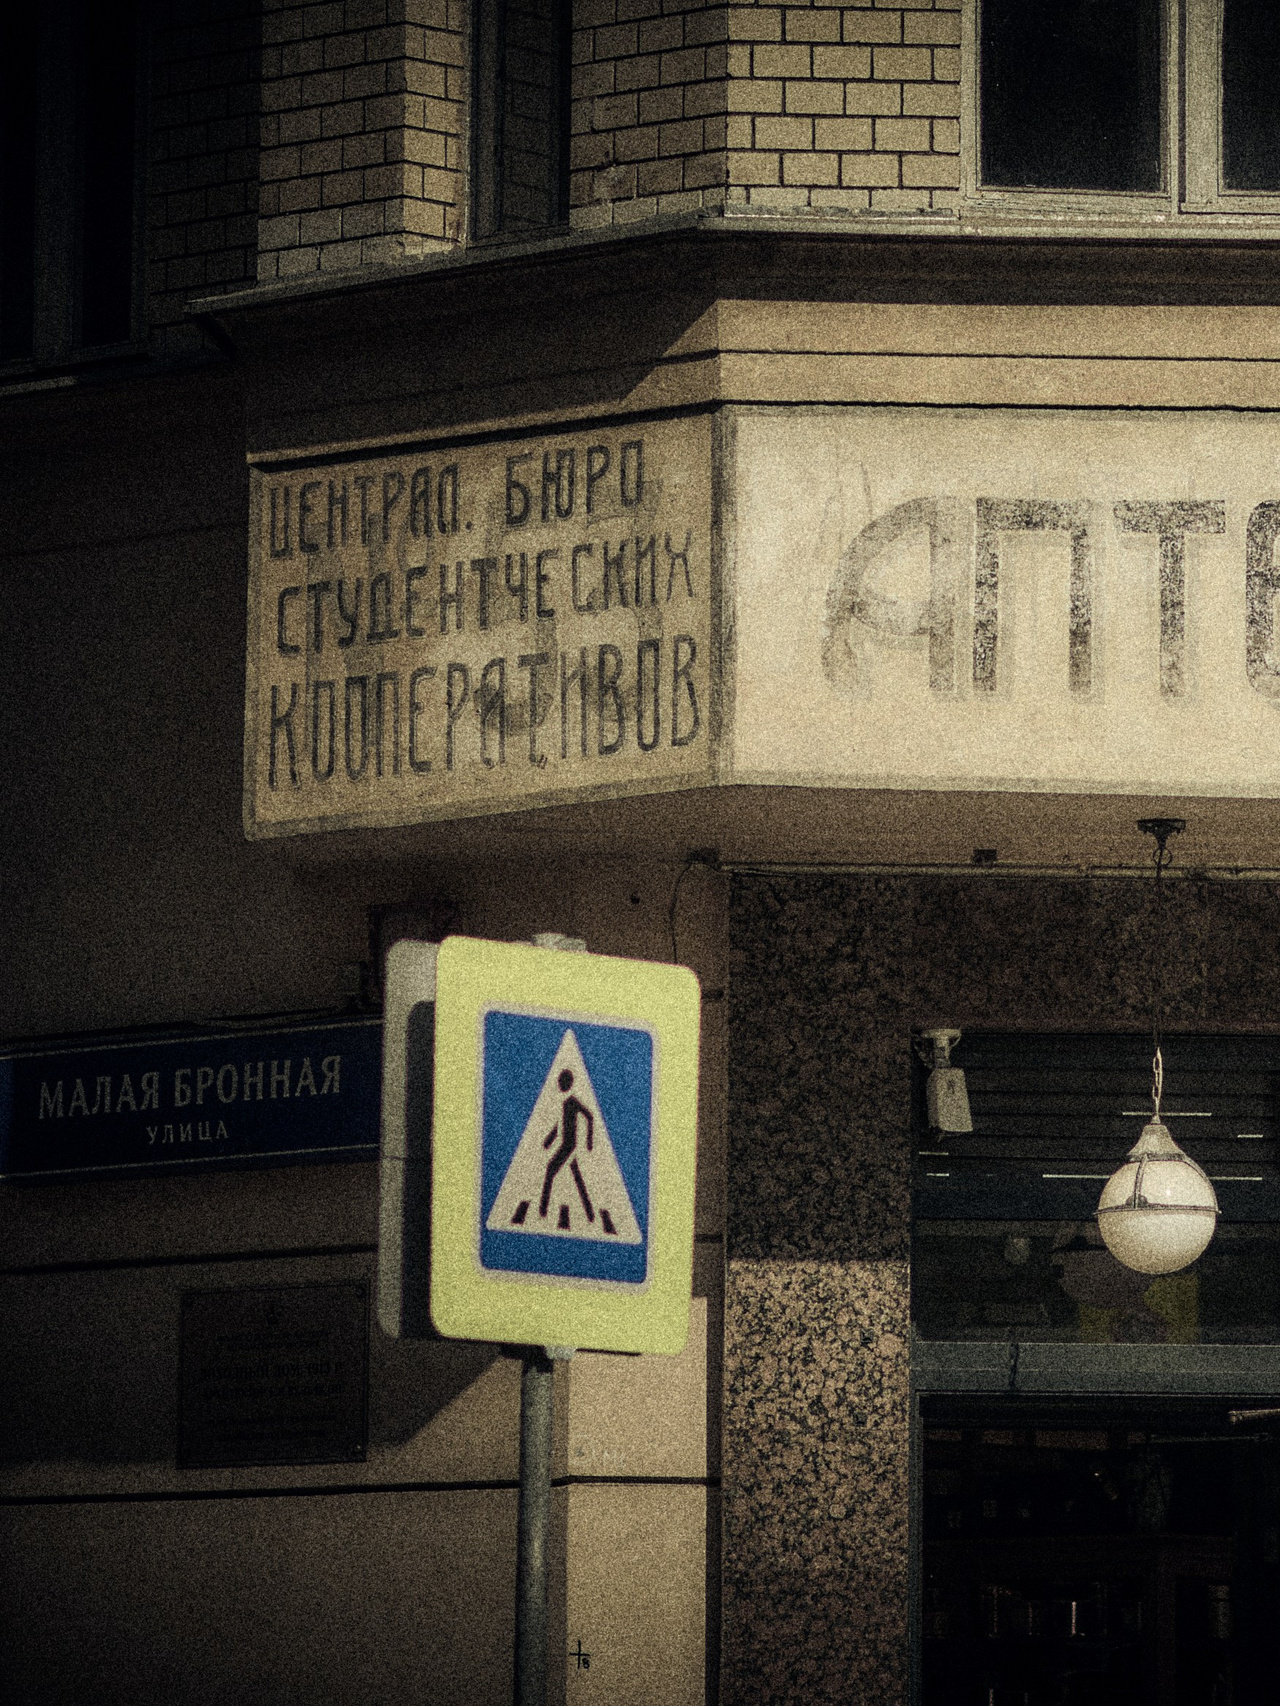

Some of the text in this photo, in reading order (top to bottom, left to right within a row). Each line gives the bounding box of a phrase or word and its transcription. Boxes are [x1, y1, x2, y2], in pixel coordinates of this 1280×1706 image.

[505, 440, 643, 527] БЮРО
[268, 633, 700, 792] КООПЕРАТИВОВ
[38, 1054, 342, 1120] МАЛАЯ БРОННАЯ
[146, 1120, 230, 1146] УЛИЦА
